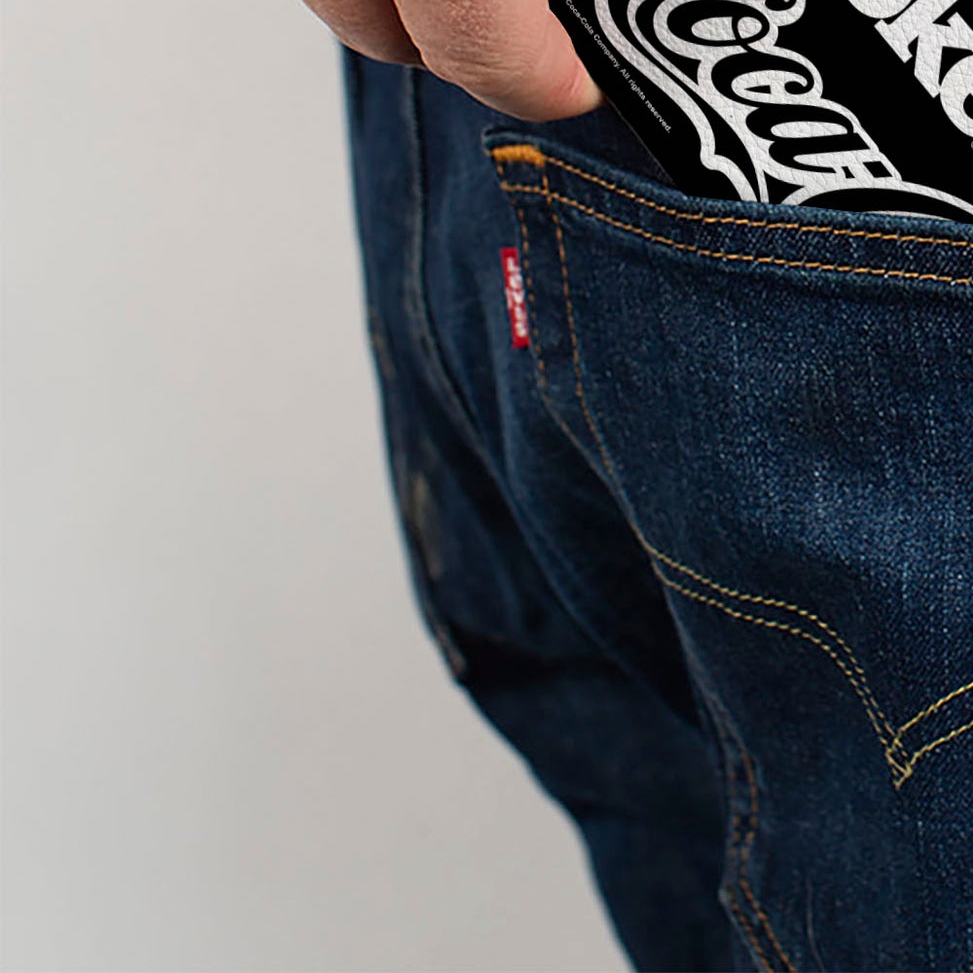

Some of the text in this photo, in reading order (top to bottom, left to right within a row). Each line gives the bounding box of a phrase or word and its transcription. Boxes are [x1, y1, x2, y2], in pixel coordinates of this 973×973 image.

[593, 33, 621, 70] Company.
[620, 68, 631, 80] All
[628, 78, 646, 101] rights
[645, 100, 672, 134] reserved.
